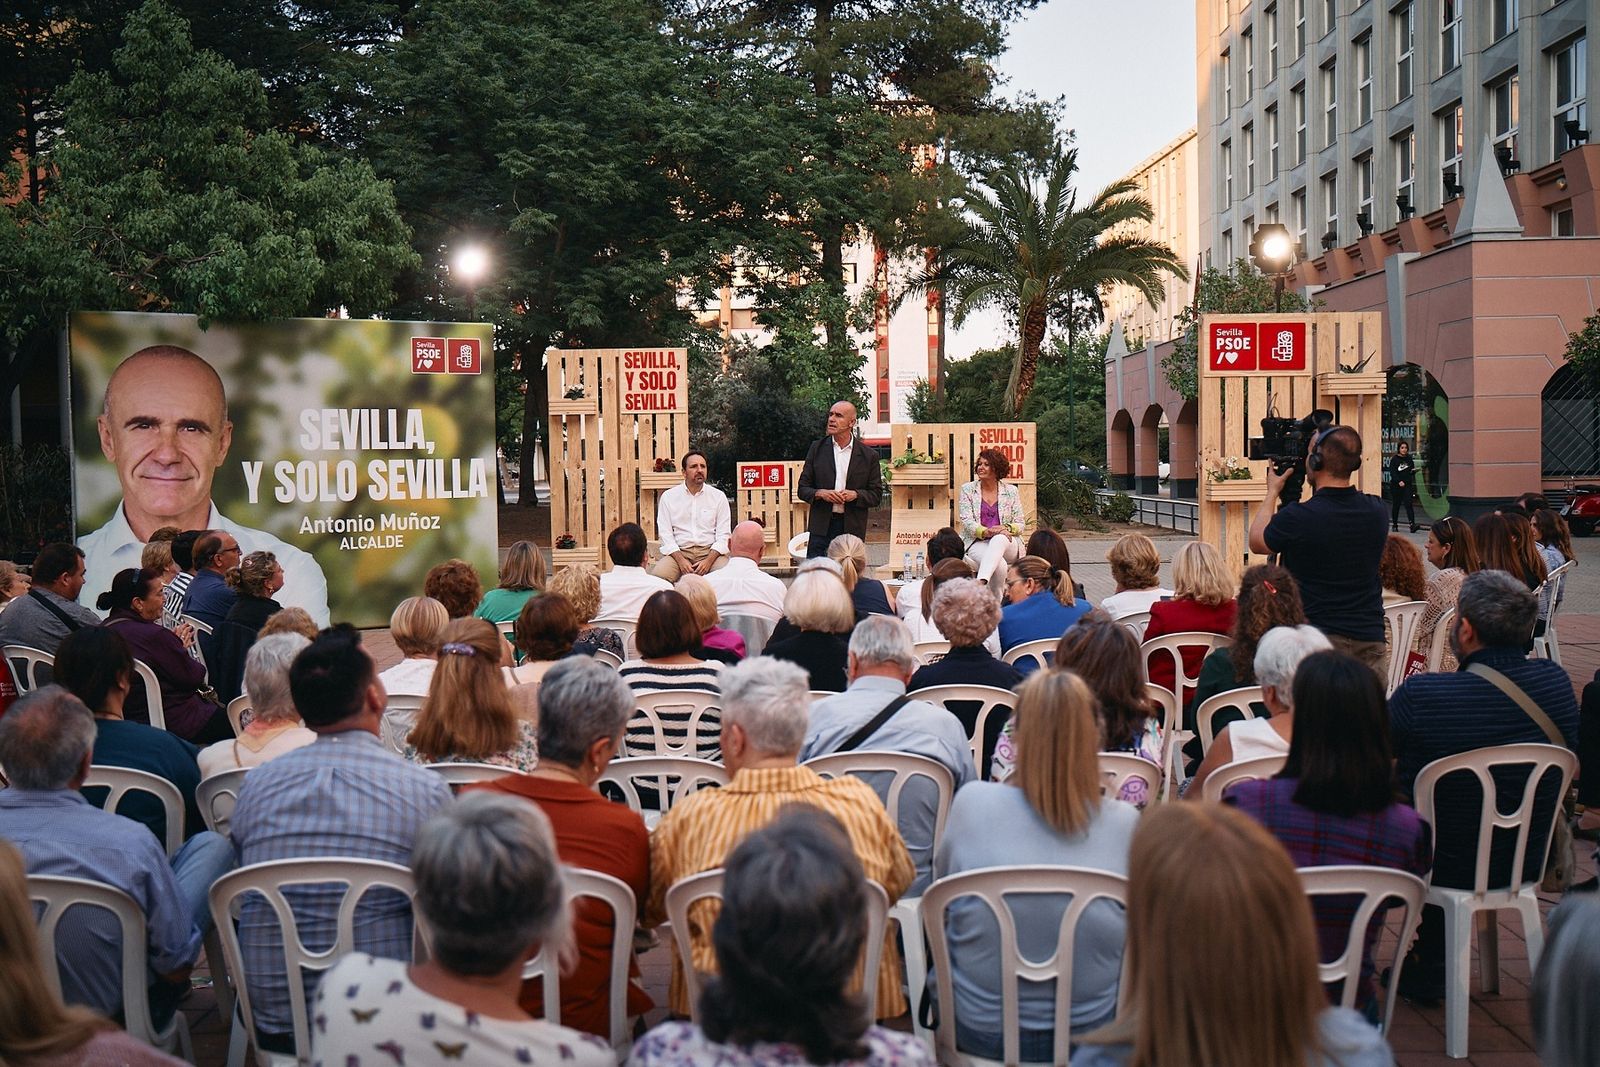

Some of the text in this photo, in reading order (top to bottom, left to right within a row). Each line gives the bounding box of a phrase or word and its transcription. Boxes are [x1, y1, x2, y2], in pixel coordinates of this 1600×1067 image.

[1216, 328, 1242, 336] Sevilla
[1216, 337, 1251, 350] PSOE
[416, 349, 441, 359] PSOE
[624, 351, 680, 370] SEVILLA,
[625, 371, 677, 391] Y SOLO
[625, 393, 677, 410] SEVILLA
[300, 408, 435, 454] SEVILLA,
[980, 428, 1027, 445] SEVILLA,
[242, 458, 488, 504] Y SOLO SEVILLA
[744, 471, 759, 479] PSOE
[299, 512, 441, 534] Antonio Muñoz
[339, 535, 404, 551] ALCALDE
